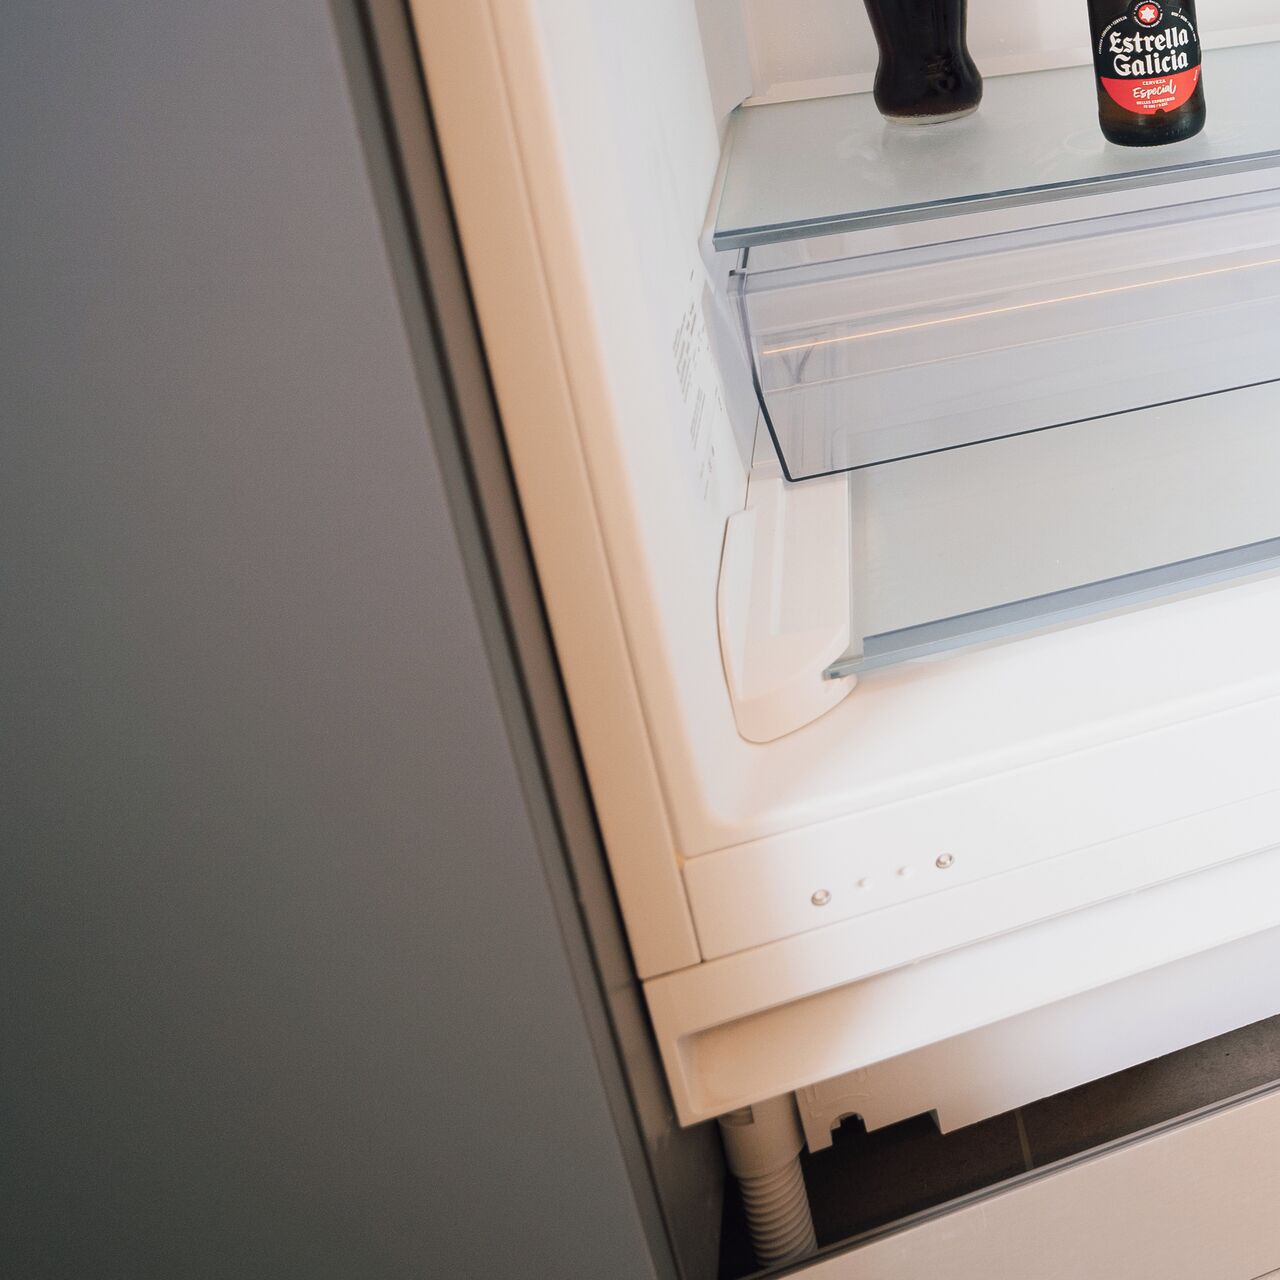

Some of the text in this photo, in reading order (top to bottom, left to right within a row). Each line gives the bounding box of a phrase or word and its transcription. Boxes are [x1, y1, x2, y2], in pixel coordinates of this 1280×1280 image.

[1109, 26, 1190, 54] Estrella
[1113, 49, 1189, 77] Galicia
[1132, 79, 1177, 99] Especial
